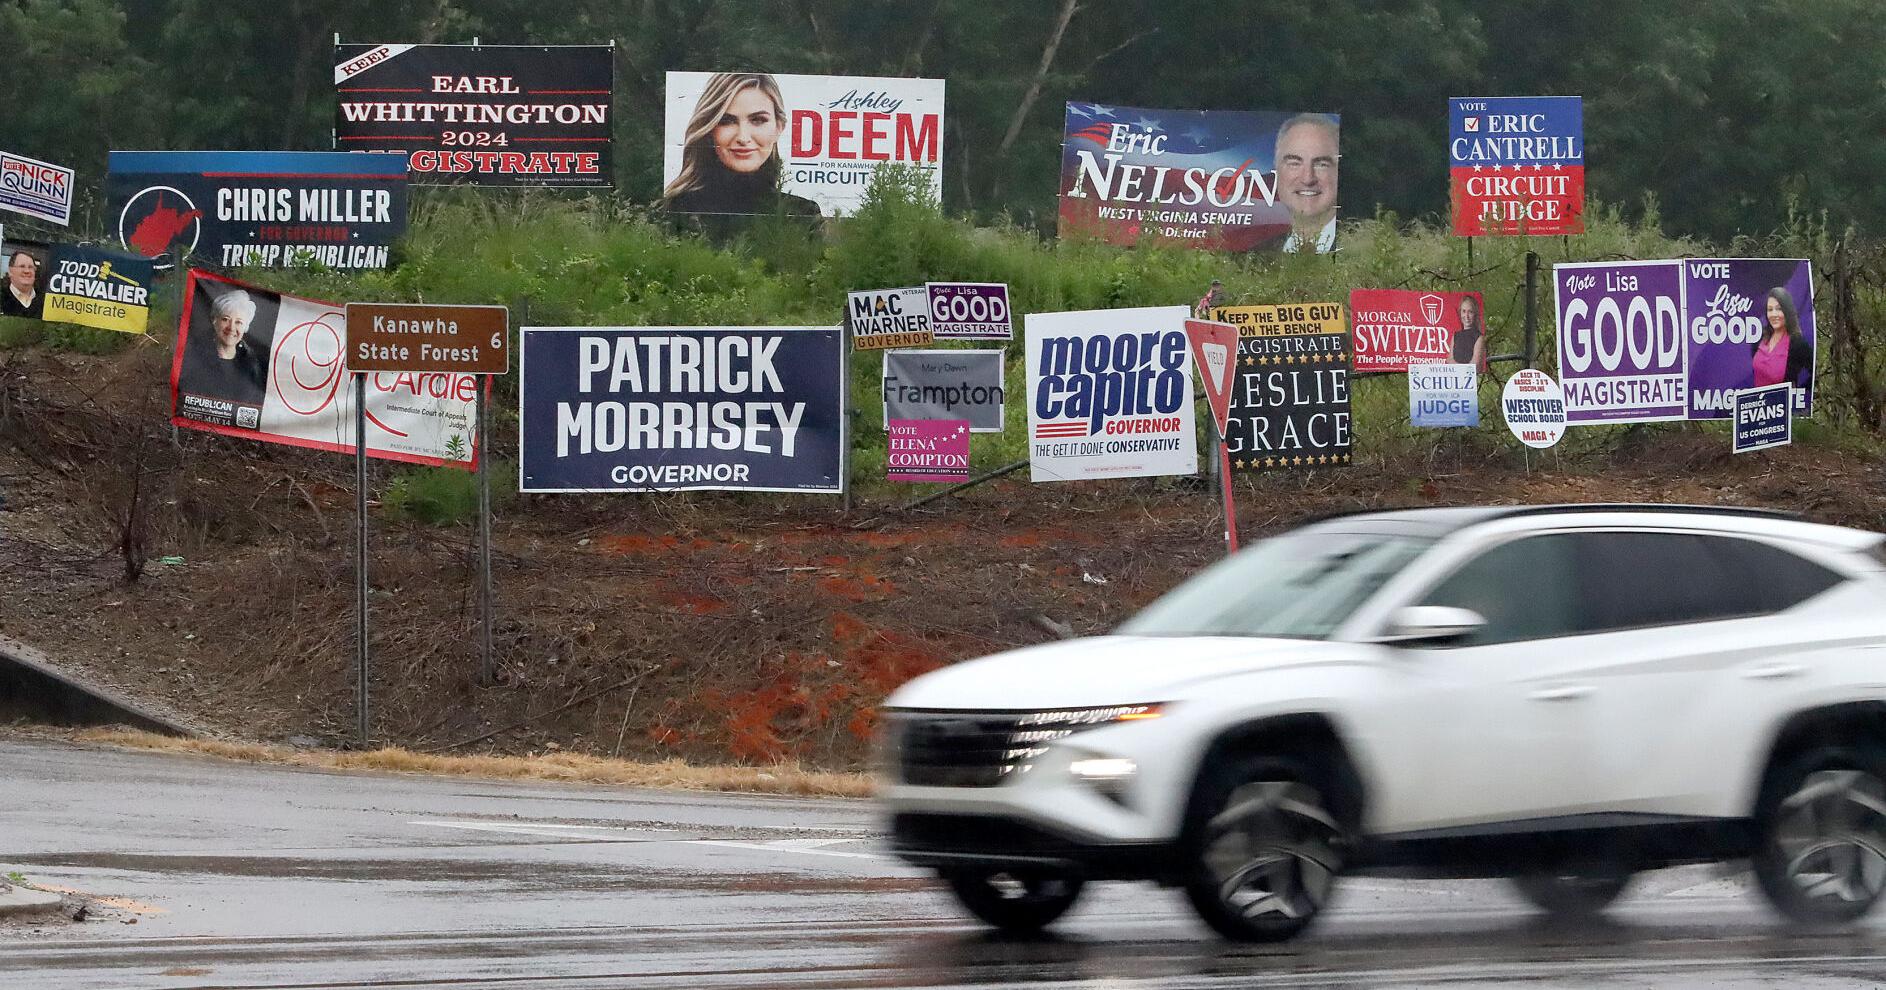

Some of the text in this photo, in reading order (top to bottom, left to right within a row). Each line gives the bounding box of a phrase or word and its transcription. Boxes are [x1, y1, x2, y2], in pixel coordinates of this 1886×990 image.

[340, 47, 390, 77] KEEP
[431, 75, 520, 94] EARL
[826, 90, 904, 114] Ashley
[1459, 103, 1487, 111] VOTE
[341, 102, 608, 124] WHITTINGTON
[1488, 114, 1545, 133] ERIC
[441, 131, 509, 147] 2024
[790, 109, 939, 162] DEEM
[1105, 123, 1168, 156] Eric
[1452, 136, 1582, 160] CANTRELL
[22, 163, 65, 187] NICK
[795, 170, 869, 185] CIRCUIT
[1067, 150, 1279, 208] NELSON
[4, 172, 65, 199] QUINN
[1466, 176, 1570, 196] CIRCUIT
[217, 187, 391, 223] CHRIS MILLER
[1478, 200, 1561, 221] JUDGE
[1098, 206, 1135, 220] WEST
[1201, 212, 1253, 226] SENATE
[260, 225, 348, 241] FOR GOVERNOR
[60, 260, 100, 278] TODD
[1690, 263, 1730, 279] VOTE
[49, 274, 148, 306] CHEVALIER
[934, 287, 978, 295] Vote Lisa
[1565, 271, 1638, 295] Vote Lisa
[51, 296, 126, 318] Magistrate
[854, 293, 903, 318] MAC
[932, 295, 1006, 322] GOOD
[1705, 284, 1754, 318] Lisa
[1253, 313, 1273, 323] THE
[1276, 307, 1305, 322] BIG
[1309, 306, 1340, 320] GUY
[1357, 311, 1411, 323] MORGAN
[373, 315, 458, 336] Kanawha
[853, 315, 929, 336] WARNER
[933, 323, 1010, 333] MAGISTRATE
[1240, 323, 1322, 336] ON THE BENCH
[1564, 295, 1679, 373] GOOD
[1691, 316, 1763, 345] GOOD
[490, 332, 502, 350] 6
[858, 333, 930, 348] GOVERNOR
[1237, 337, 1341, 355] AGISTRATE
[1355, 324, 1450, 354] SWITZER
[358, 343, 480, 362] State Forest
[1039, 331, 1186, 376] moore
[1207, 351, 1223, 365] YIELD
[1356, 355, 1447, 365] The People's Prosecutor
[579, 336, 785, 394] PATRICK
[1413, 376, 1474, 390] SCHULZ
[1563, 378, 1684, 407] MAGISTRATE
[184, 395, 233, 412] REPUBLICAN
[884, 376, 1004, 412] Frampton
[1036, 364, 1185, 437] capito
[421, 408, 437, 417] Court
[1416, 399, 1470, 418] JUDGE
[1505, 399, 1563, 413] WESTOVER
[1740, 399, 1766, 410] DERRICK
[1740, 404, 1785, 424] EVANS
[1106, 417, 1181, 435] GOVERNOR
[1508, 414, 1564, 423] SCHOOL BOARD
[557, 401, 806, 458] MORRISEY
[891, 426, 917, 435] VOTE
[1226, 412, 1350, 453] GRACE
[1522, 431, 1547, 441] MAGA
[1740, 425, 1785, 439] US CONGRESS
[891, 438, 936, 451] ELENA
[1035, 438, 1180, 457] THE GET IT DONE CONSERVATIVE
[889, 453, 967, 466] COMPTON
[611, 464, 749, 484] GOVERNOR
